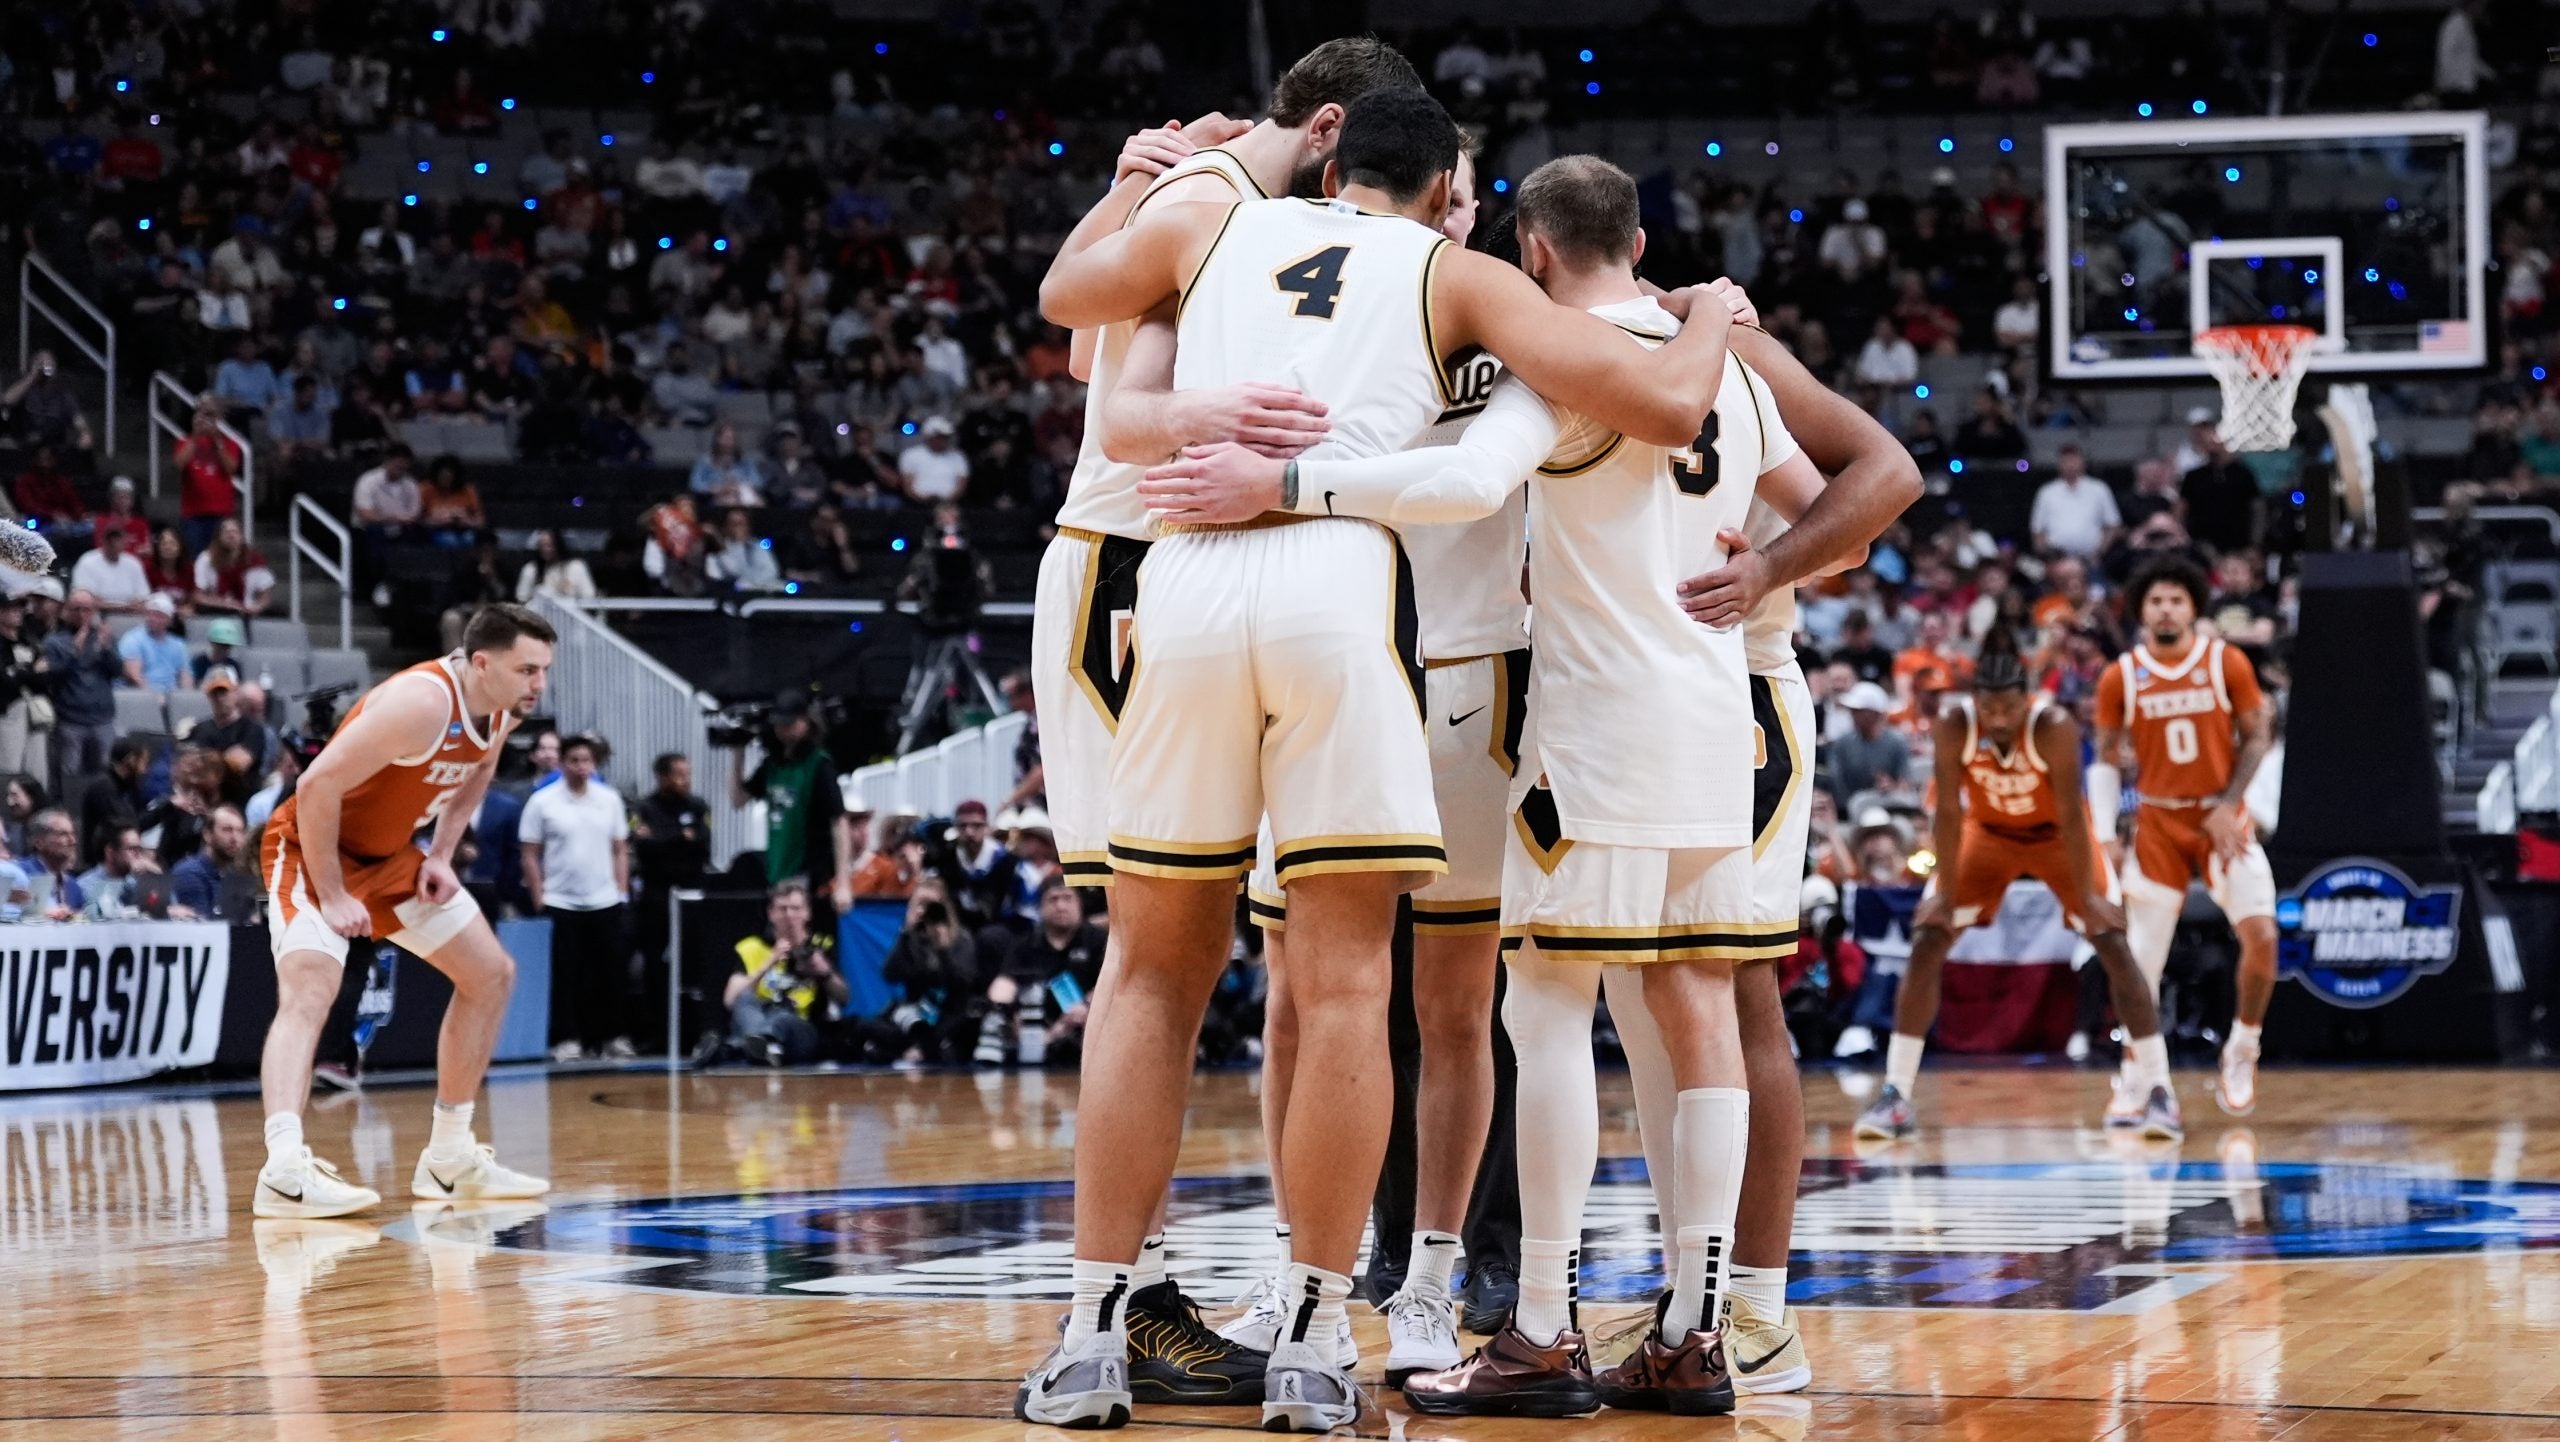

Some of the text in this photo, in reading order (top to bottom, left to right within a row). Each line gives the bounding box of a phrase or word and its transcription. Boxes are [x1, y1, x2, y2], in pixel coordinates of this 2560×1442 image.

[1270, 243, 1353, 321] 4
[2138, 687, 2216, 719] TEXAS
[2165, 718, 2199, 765] 0
[2302, 897, 2406, 932] MARCH
[2314, 926, 2453, 961] MADNESS
[0, 946, 211, 1065] VERSITY
